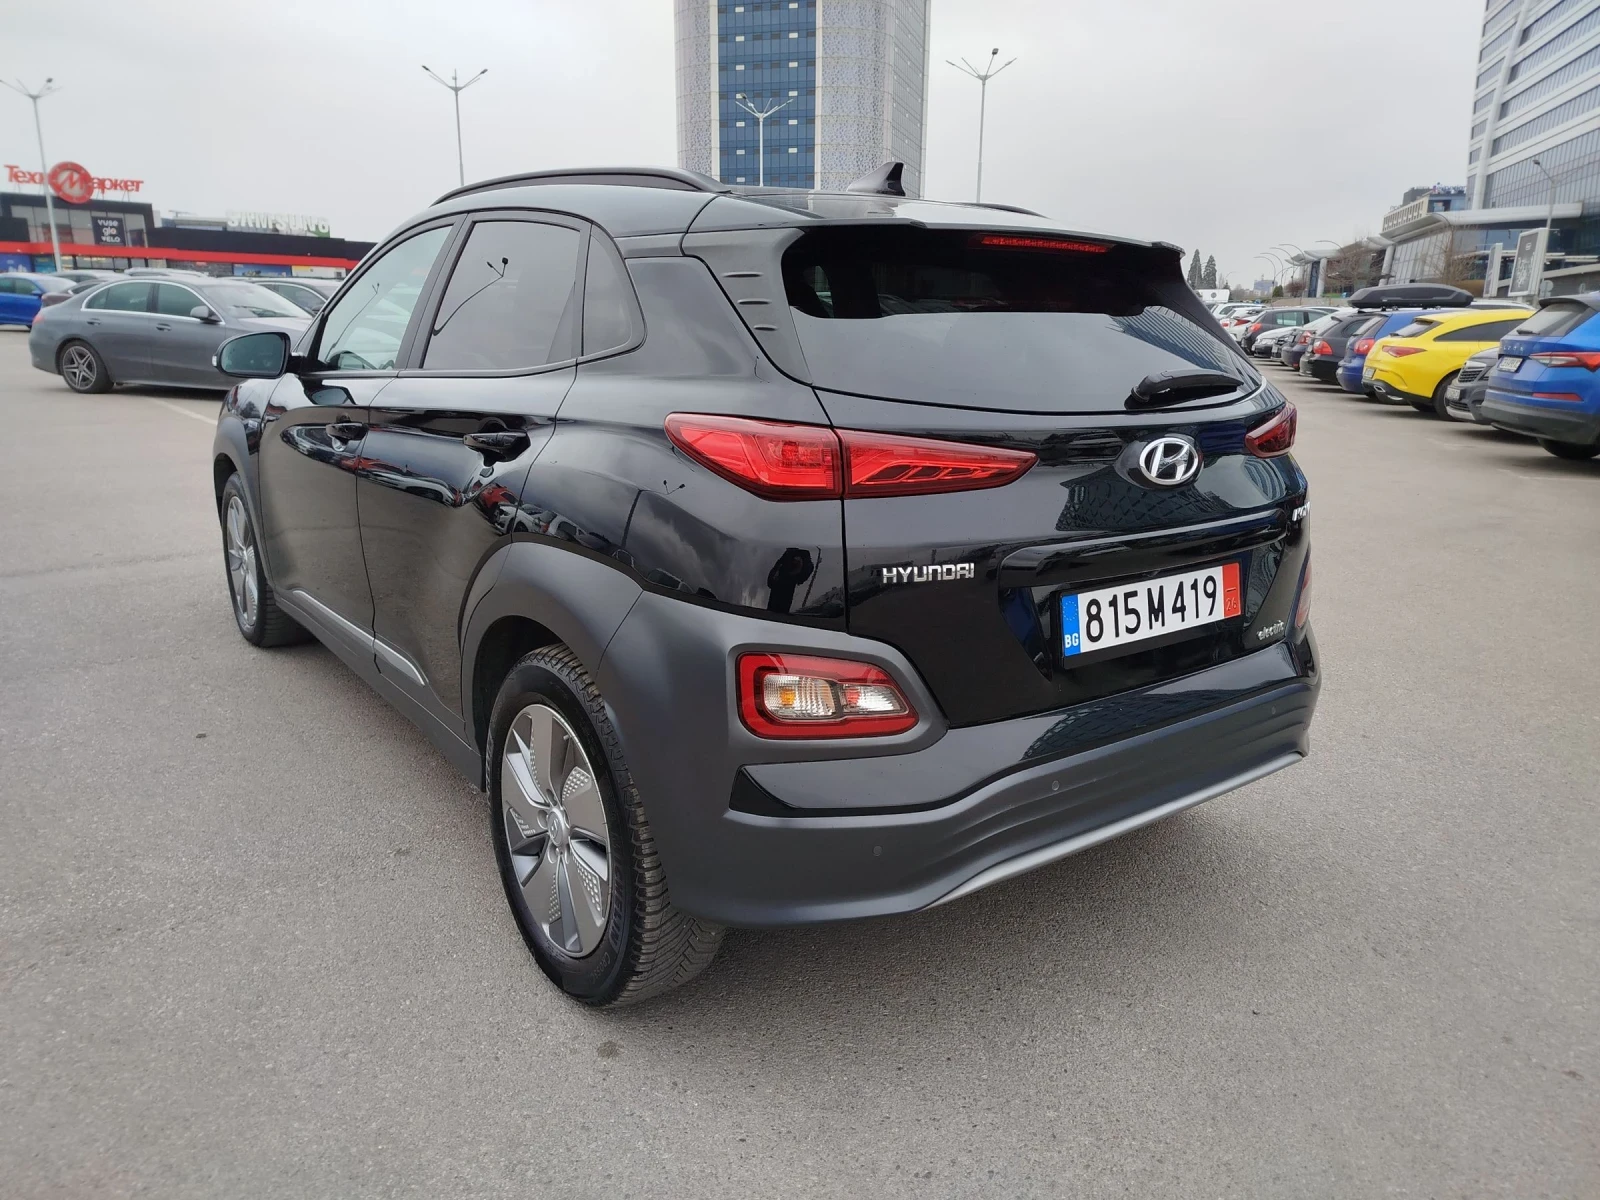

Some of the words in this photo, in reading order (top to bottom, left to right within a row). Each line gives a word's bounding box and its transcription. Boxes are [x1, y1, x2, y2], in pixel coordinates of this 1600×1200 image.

[226, 210, 330, 233] SAMSUNG
[101, 235, 120, 243] VELO
[882, 562, 975, 584] HYUNDAI
[1085, 575, 1217, 643] 815M419
[1226, 597, 1238, 612] 26
[1064, 633, 1079, 648] BG
[1256, 619, 1284, 641] electric
